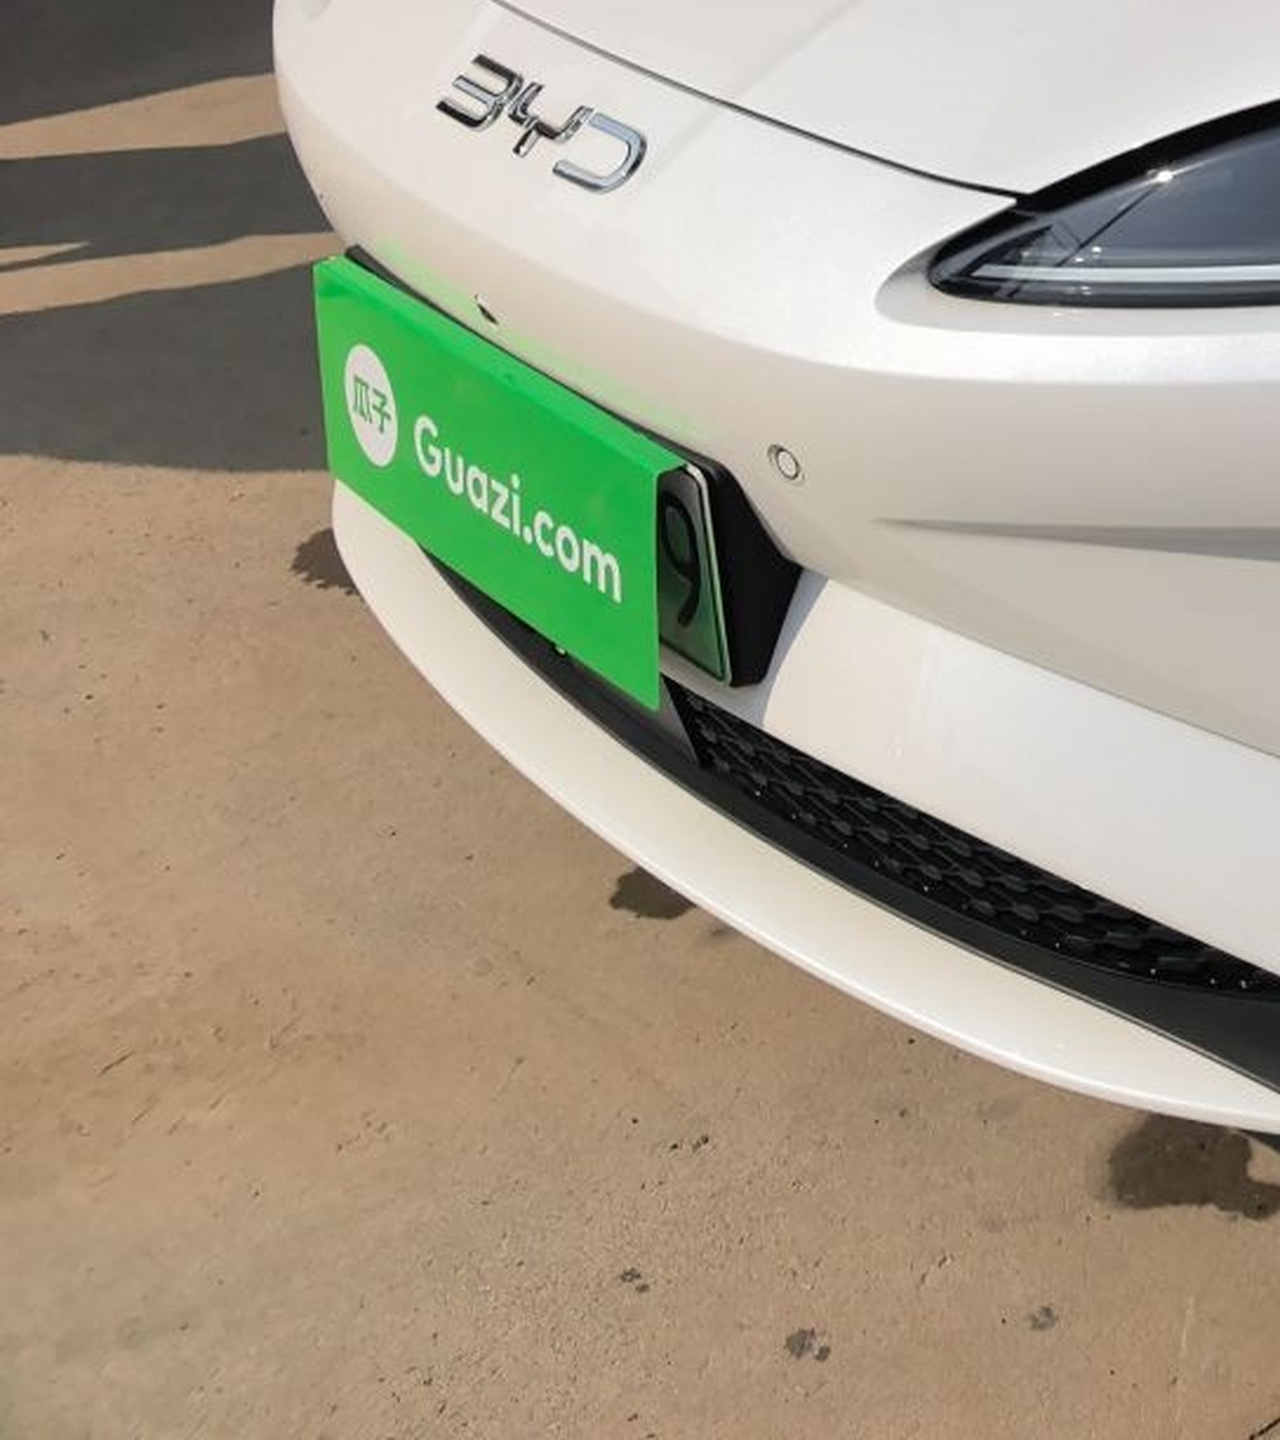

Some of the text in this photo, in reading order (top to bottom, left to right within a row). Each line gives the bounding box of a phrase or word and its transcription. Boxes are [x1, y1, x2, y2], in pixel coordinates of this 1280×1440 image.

[435, 53, 647, 194] BYD
[352, 374, 392, 435] 瓜子
[412, 414, 623, 604] Guazi.com
